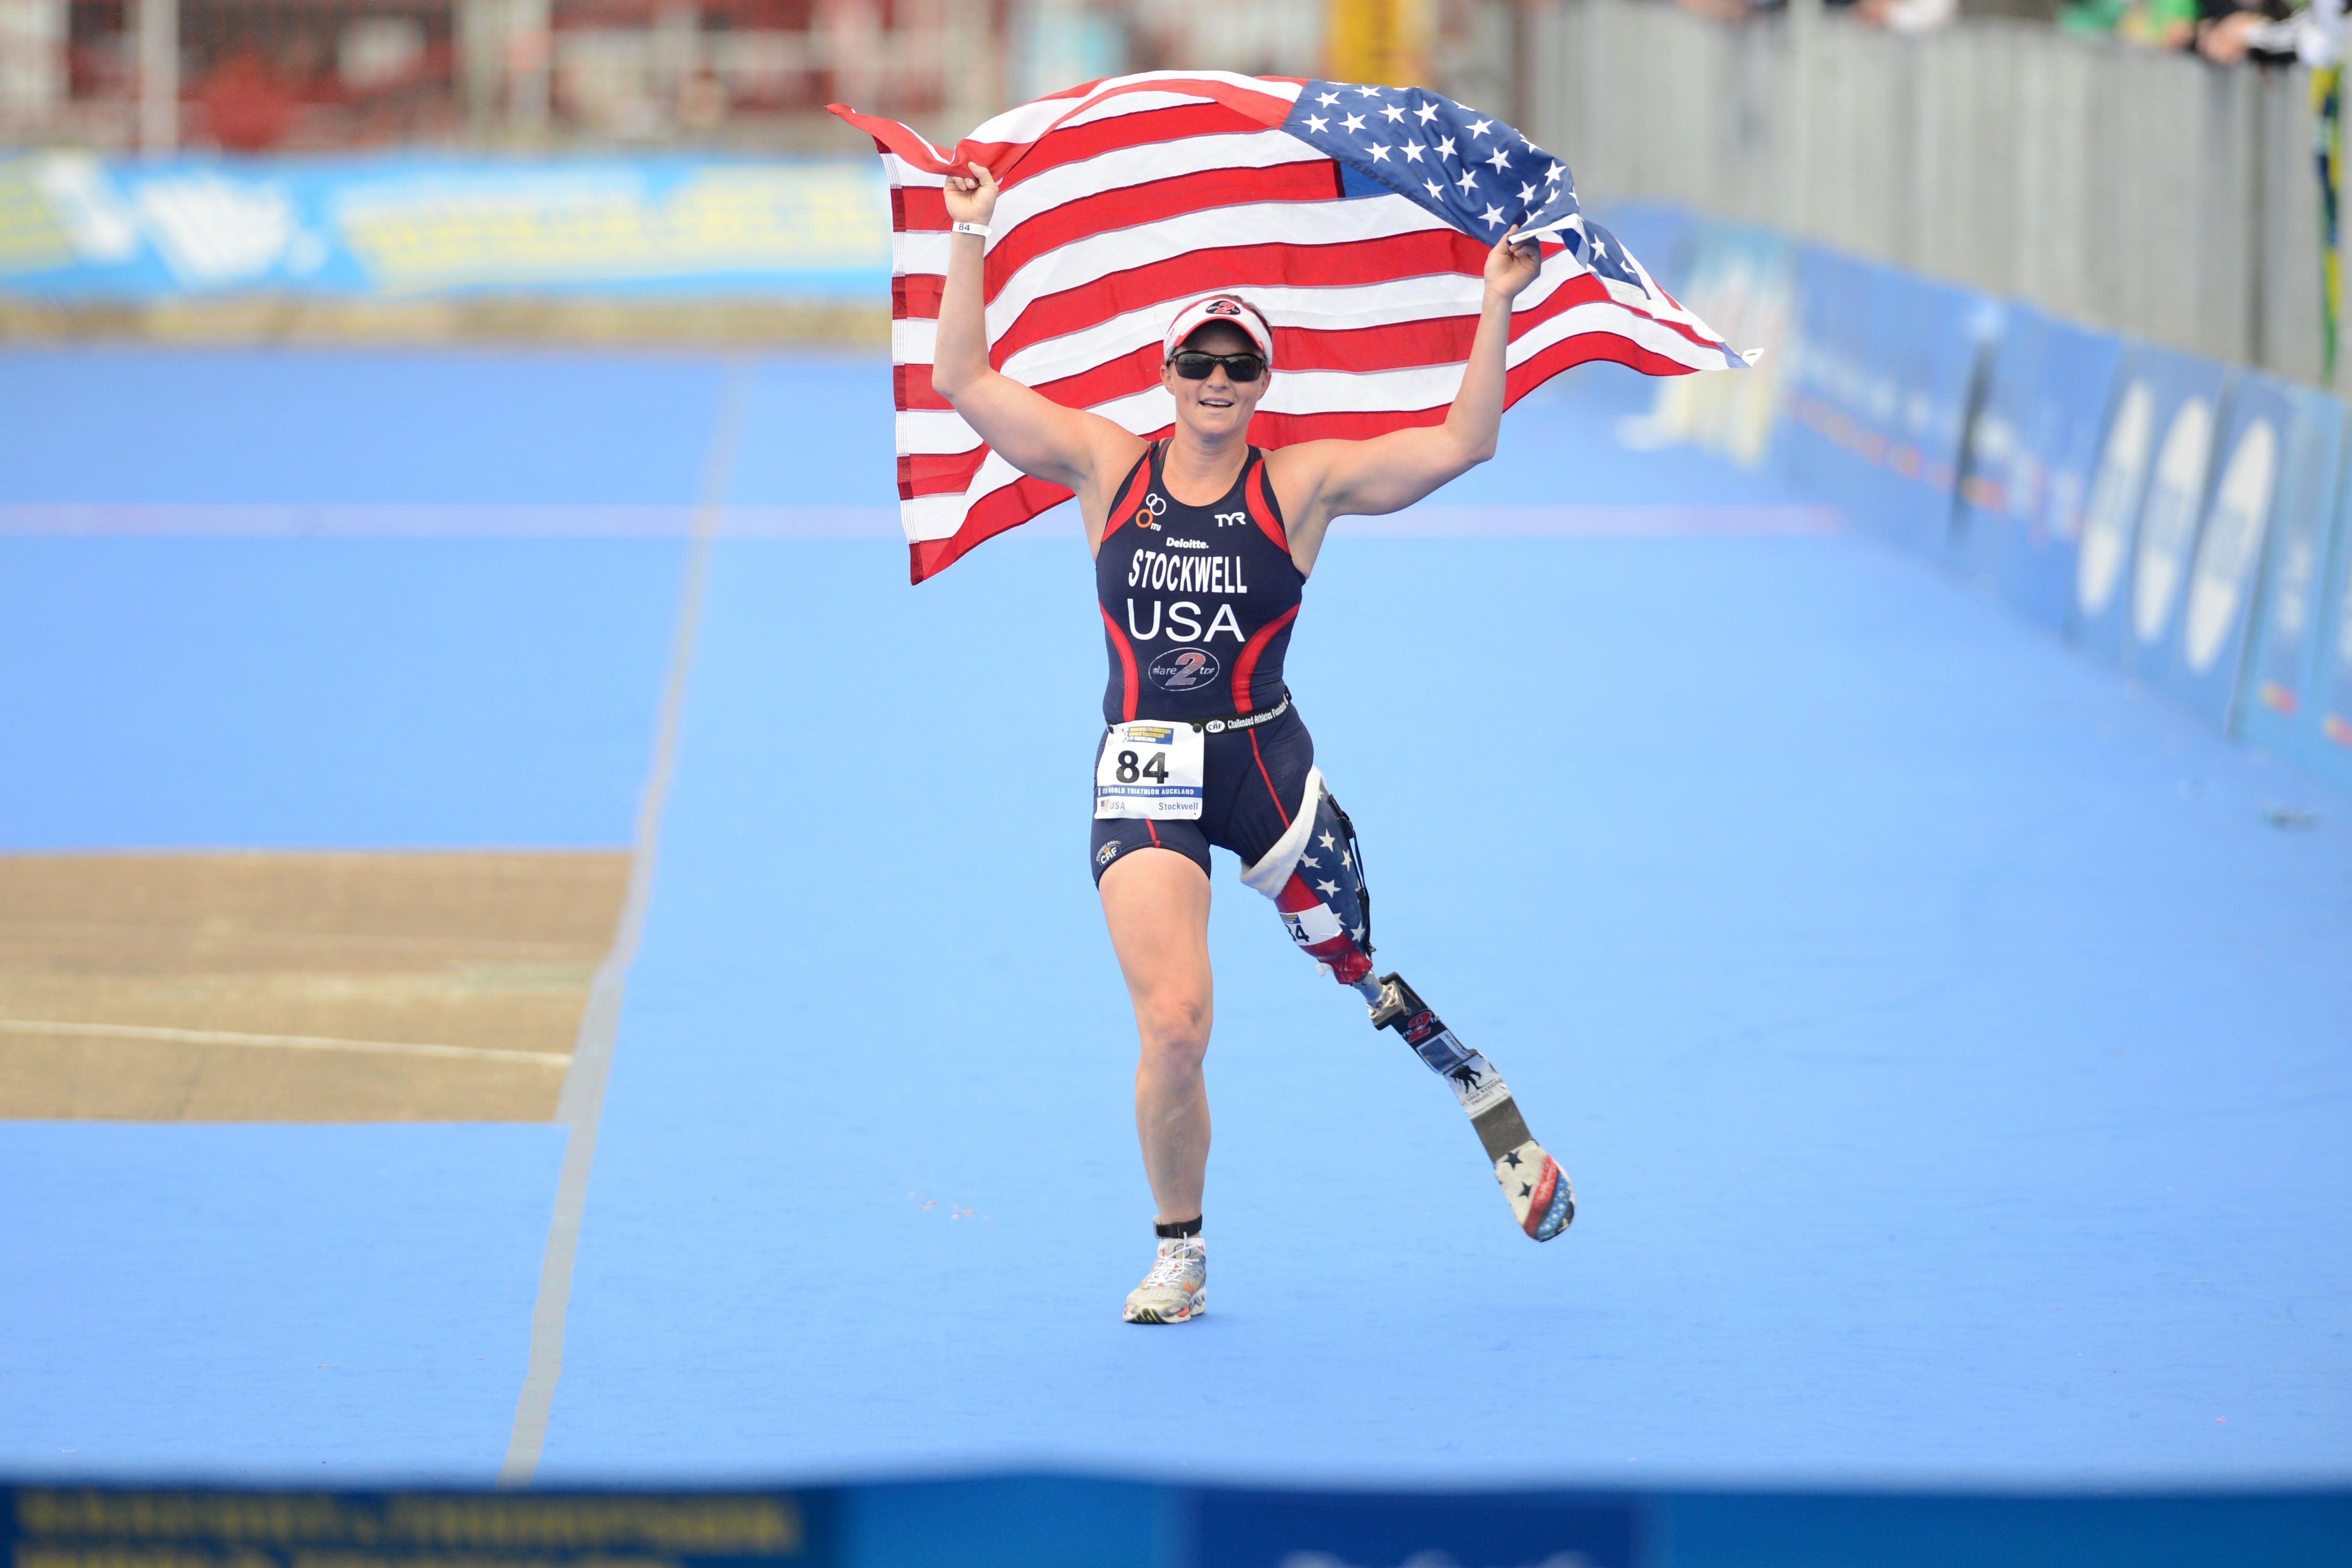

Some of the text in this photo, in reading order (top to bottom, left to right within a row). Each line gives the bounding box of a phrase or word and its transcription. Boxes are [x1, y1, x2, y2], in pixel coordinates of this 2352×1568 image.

[958, 223, 970, 231] 84
[1214, 302, 1235, 314] 2
[1150, 522, 1162, 531] ITU
[1214, 512, 1246, 527] TYR
[1128, 549, 1247, 593] STOCKWELL
[1127, 598, 1246, 642] USA
[1152, 665, 1177, 675] dare
[1165, 652, 1206, 686] 2
[1227, 717, 1254, 729] Challenged
[1254, 712, 1273, 725] Athletes
[1116, 751, 1169, 784] 84
[1110, 802, 1198, 811] USA Stockwell
[1101, 847, 1117, 865] CAF
[1408, 1011, 1432, 1043] 2
